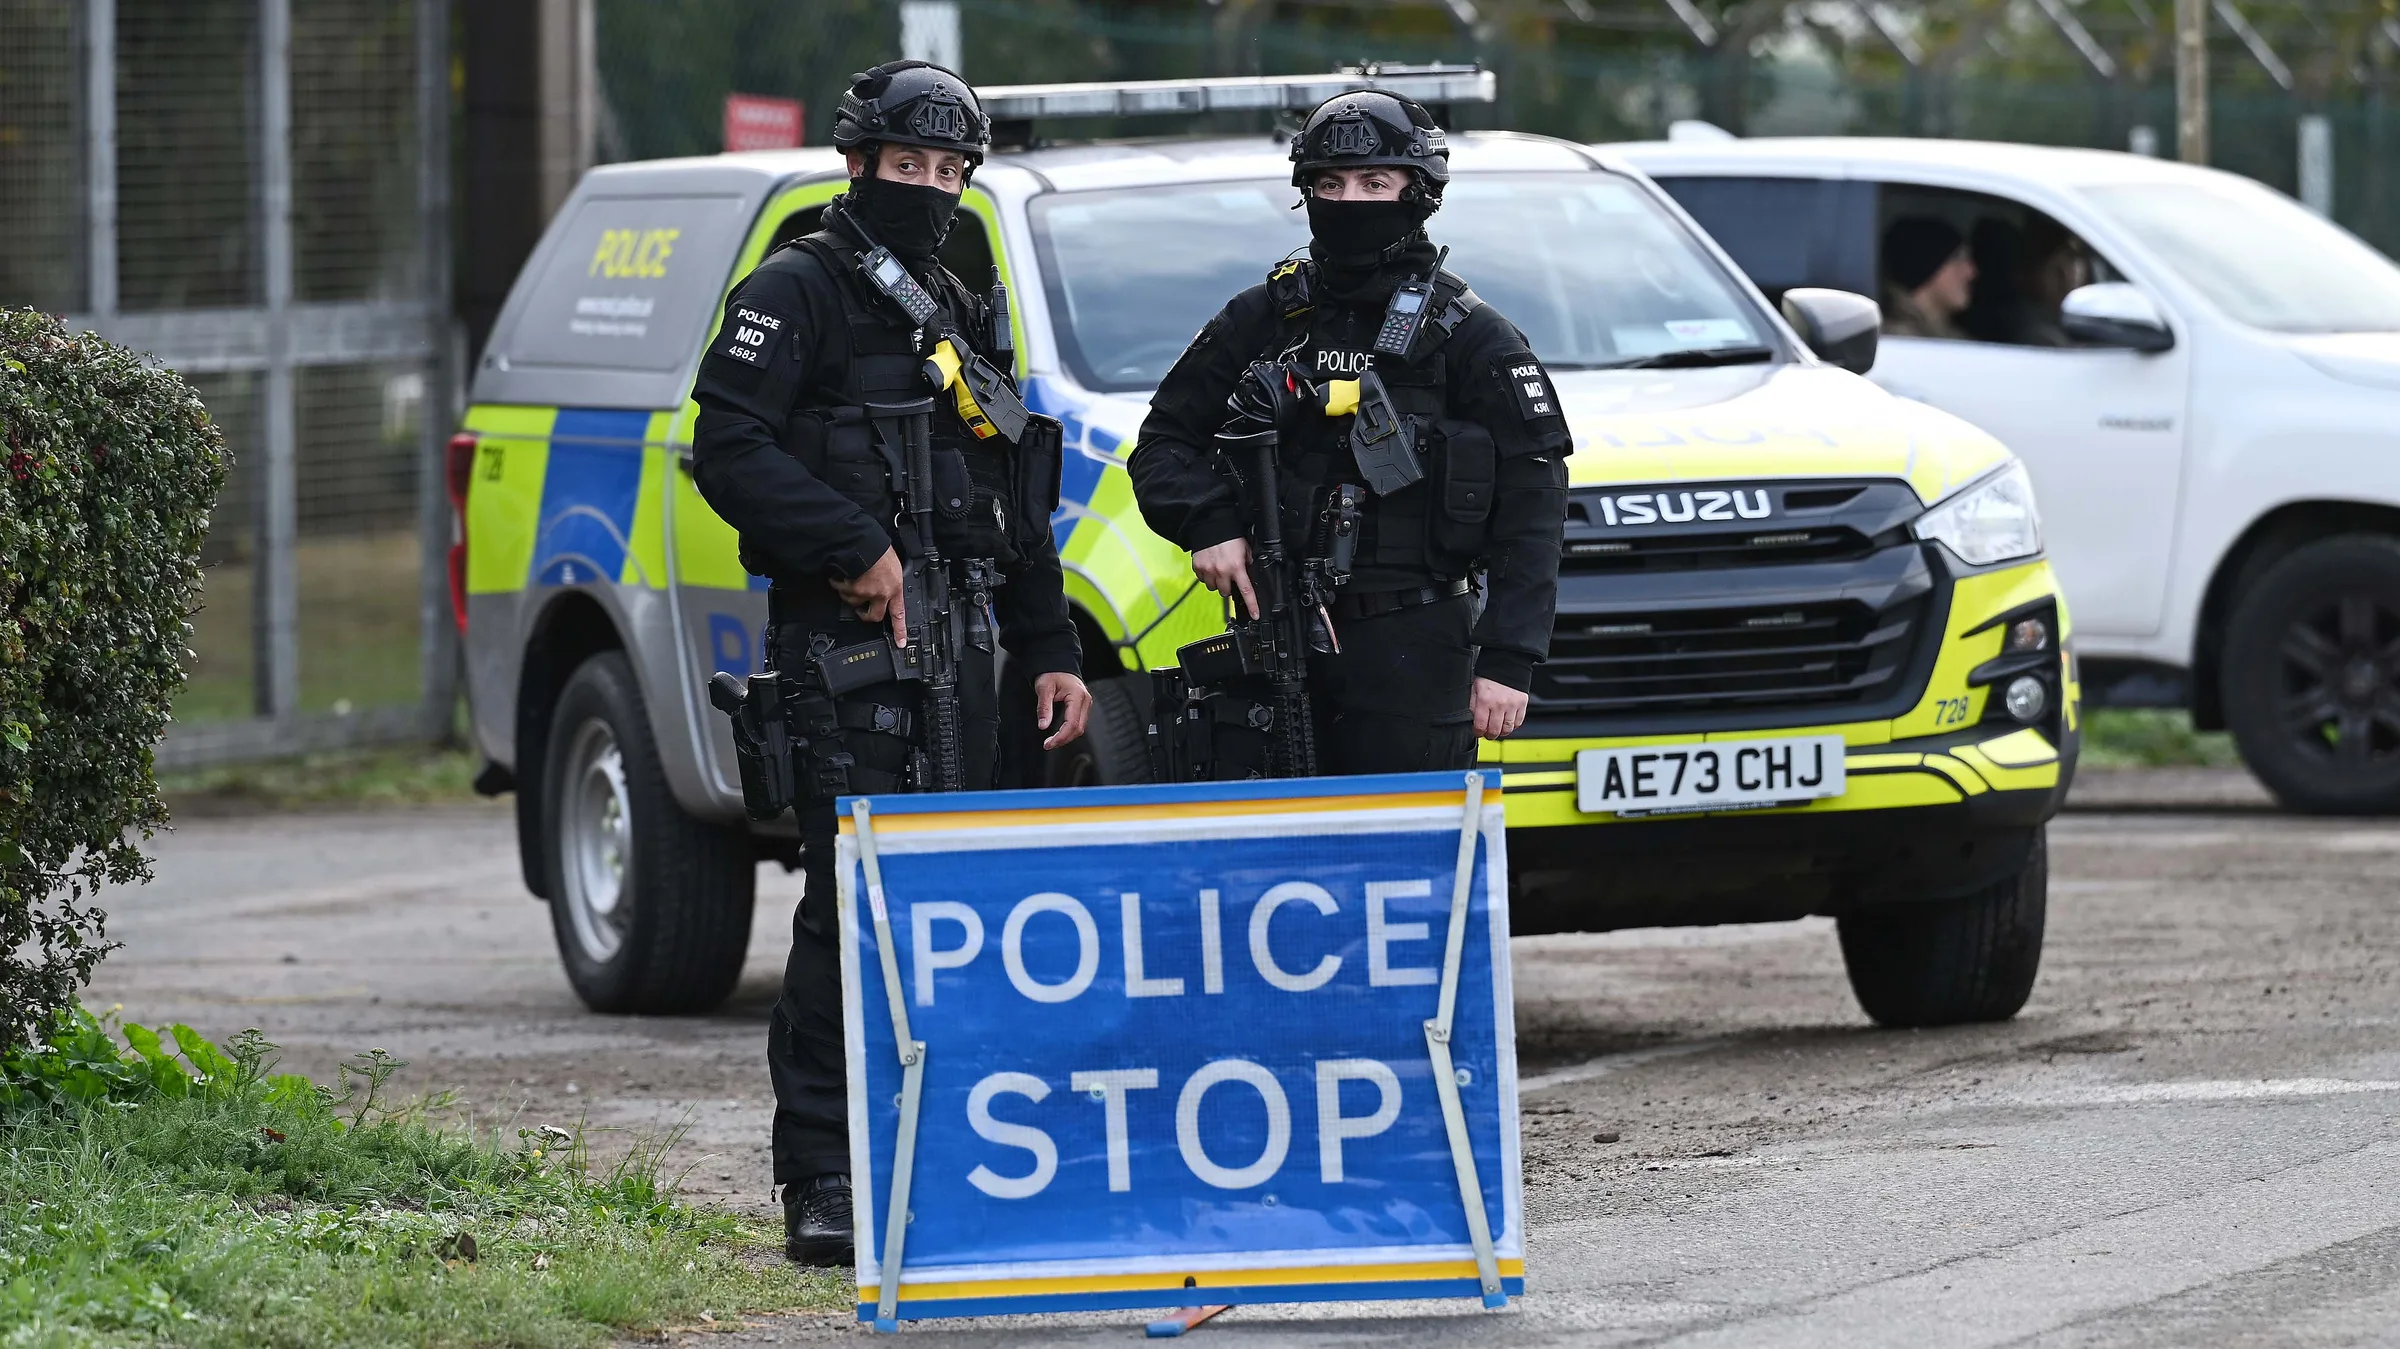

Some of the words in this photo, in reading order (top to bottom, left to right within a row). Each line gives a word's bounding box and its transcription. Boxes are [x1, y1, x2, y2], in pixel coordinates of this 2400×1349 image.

[588, 228, 680, 279] POLICE
[737, 308, 781, 330] POLICE
[735, 325, 765, 347] MD
[728, 345, 757, 362] 4582
[1316, 350, 1375, 374] POLICE
[1511, 365, 1541, 378] POLICE
[1524, 381, 1544, 398] MD
[1600, 489, 1772, 526] ISUZU
[1936, 696, 1968, 725] 728
[1602, 751, 1720, 800] AE73
[1735, 744, 1823, 791] CHJ
[911, 880, 1438, 1006] POLICE
[965, 1057, 1404, 1200] STOP
